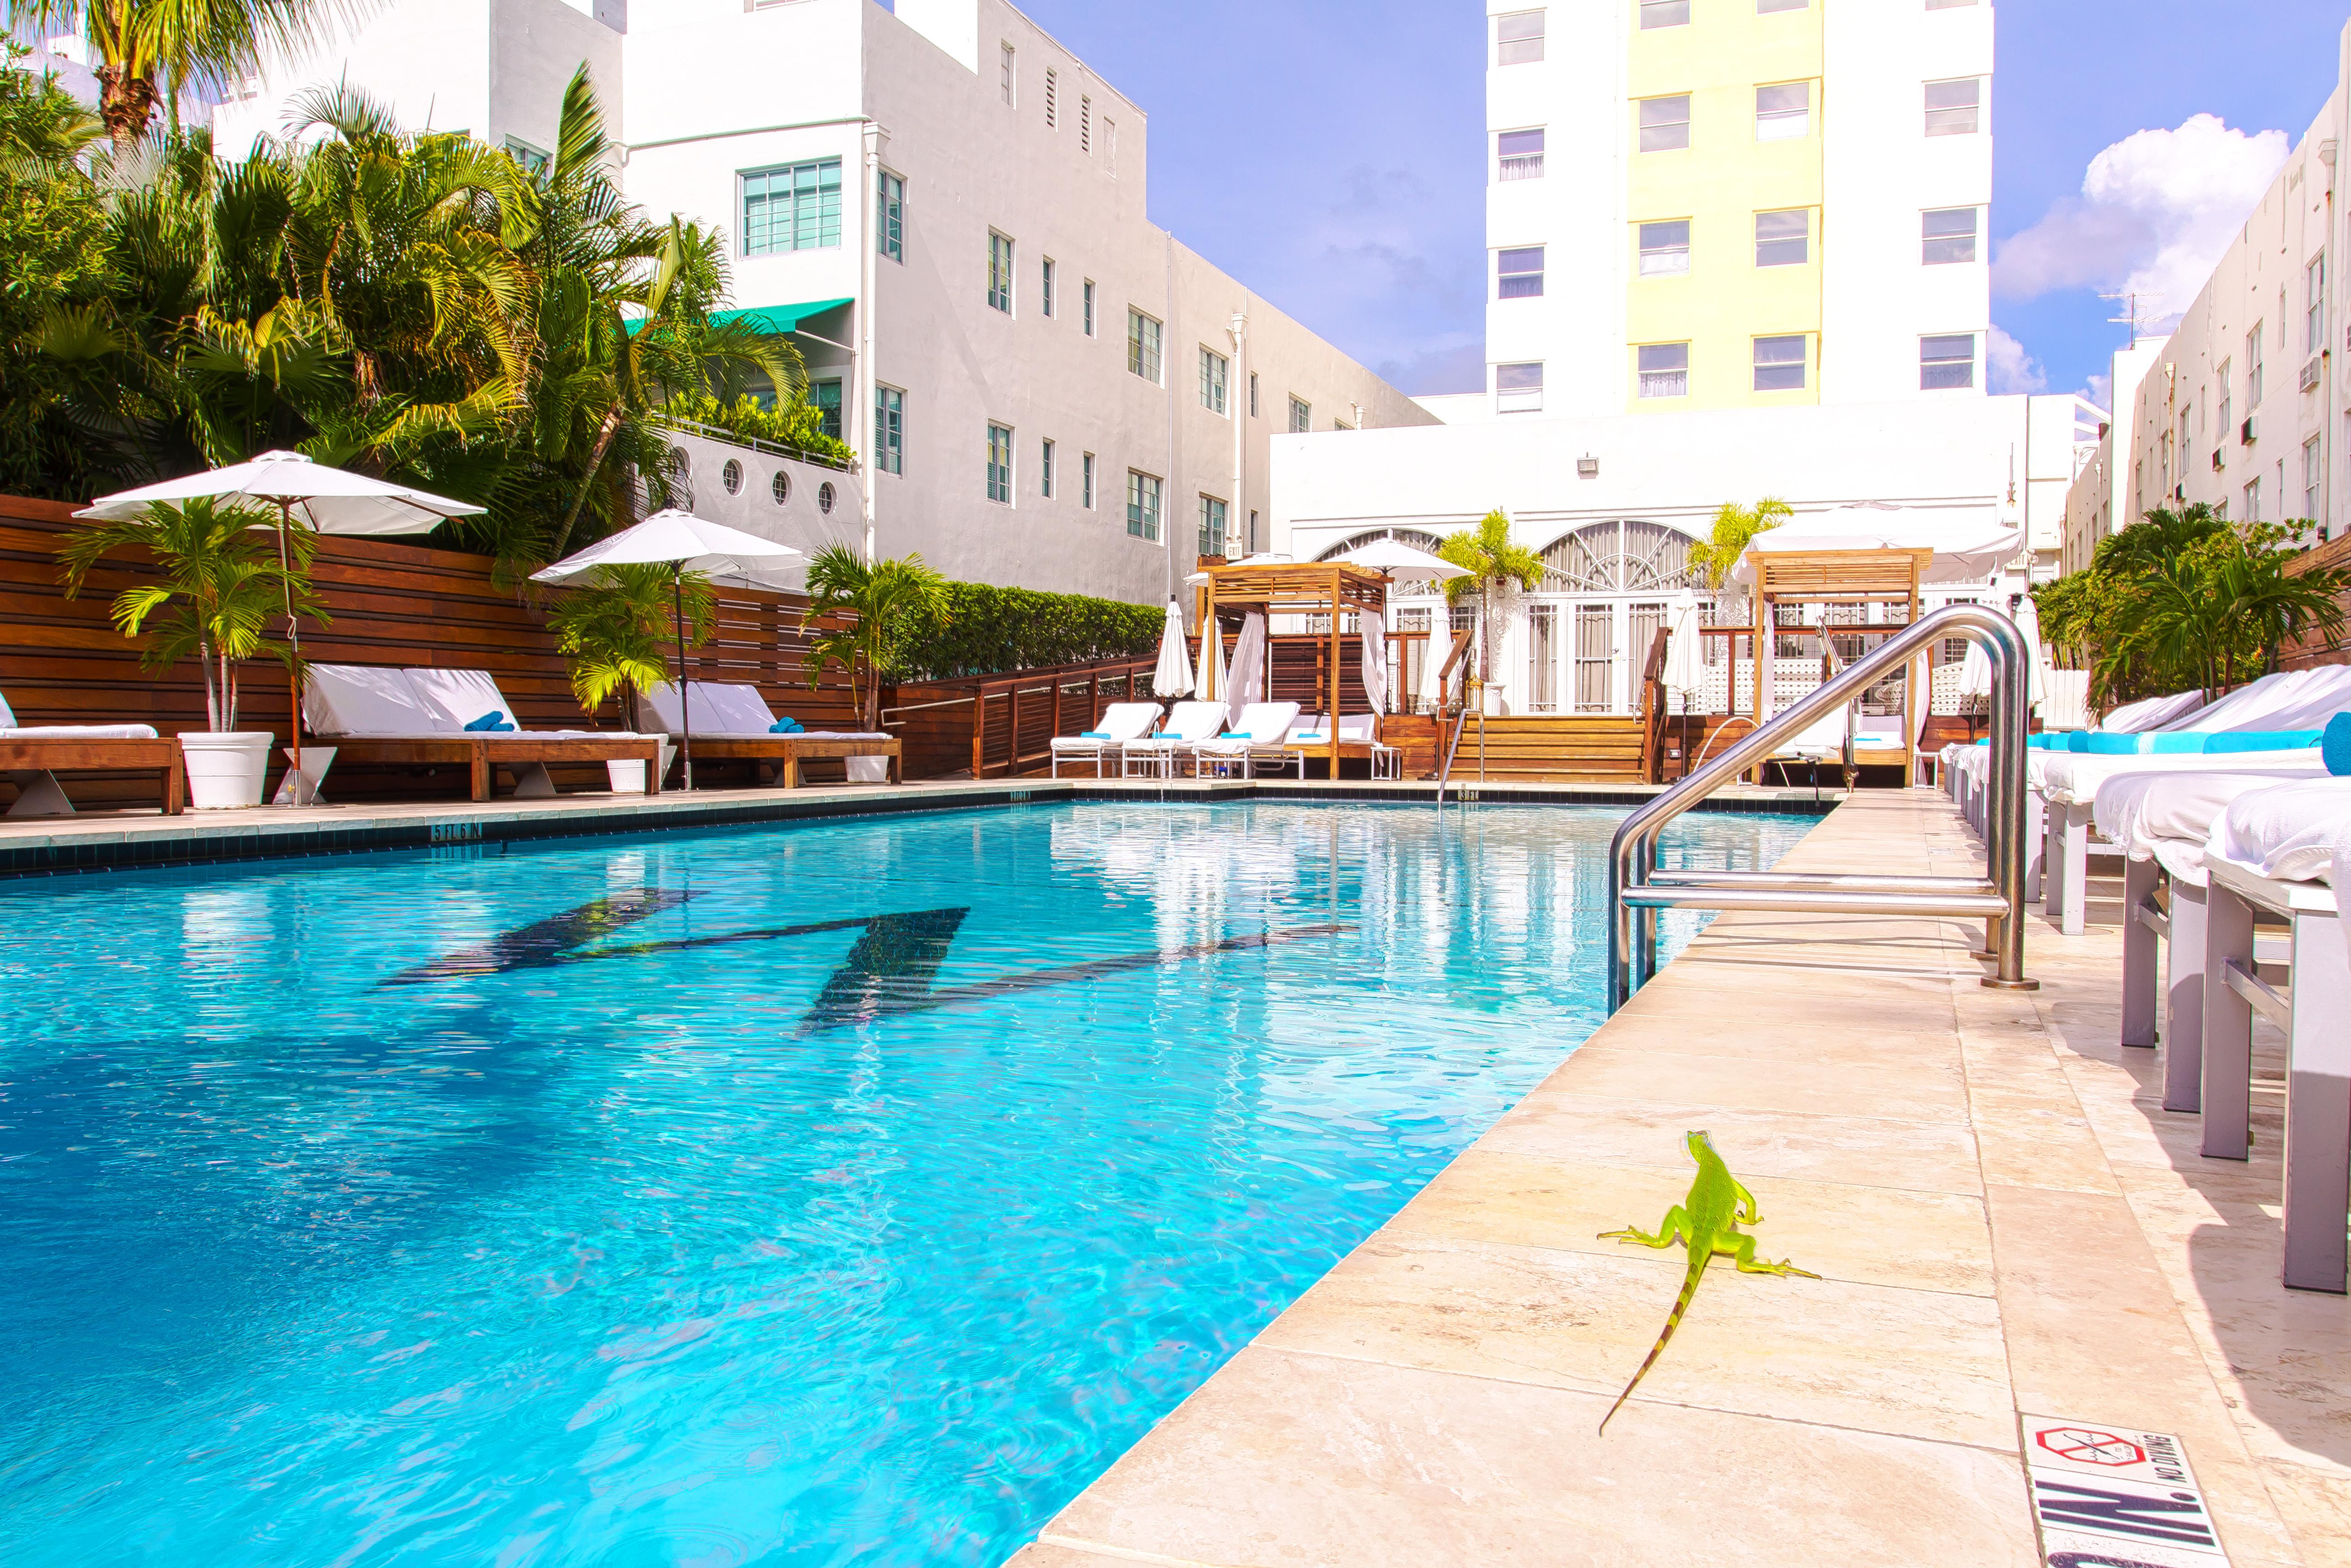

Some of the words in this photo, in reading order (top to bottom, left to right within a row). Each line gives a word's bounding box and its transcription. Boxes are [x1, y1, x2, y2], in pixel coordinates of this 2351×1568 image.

[1228, 547, 1240, 556] EXIT
[1460, 789, 1465, 800] 3
[1469, 790, 1478, 801] FT.
[435, 824, 440, 840] 5
[445, 824, 456, 840] FT.
[460, 823, 466, 839] 6
[470, 823, 481, 839] IN.
[2143, 1434, 2182, 1467] DIVING
[2154, 1466, 2188, 1484] NO
[2035, 1479, 2216, 1547] IN.
